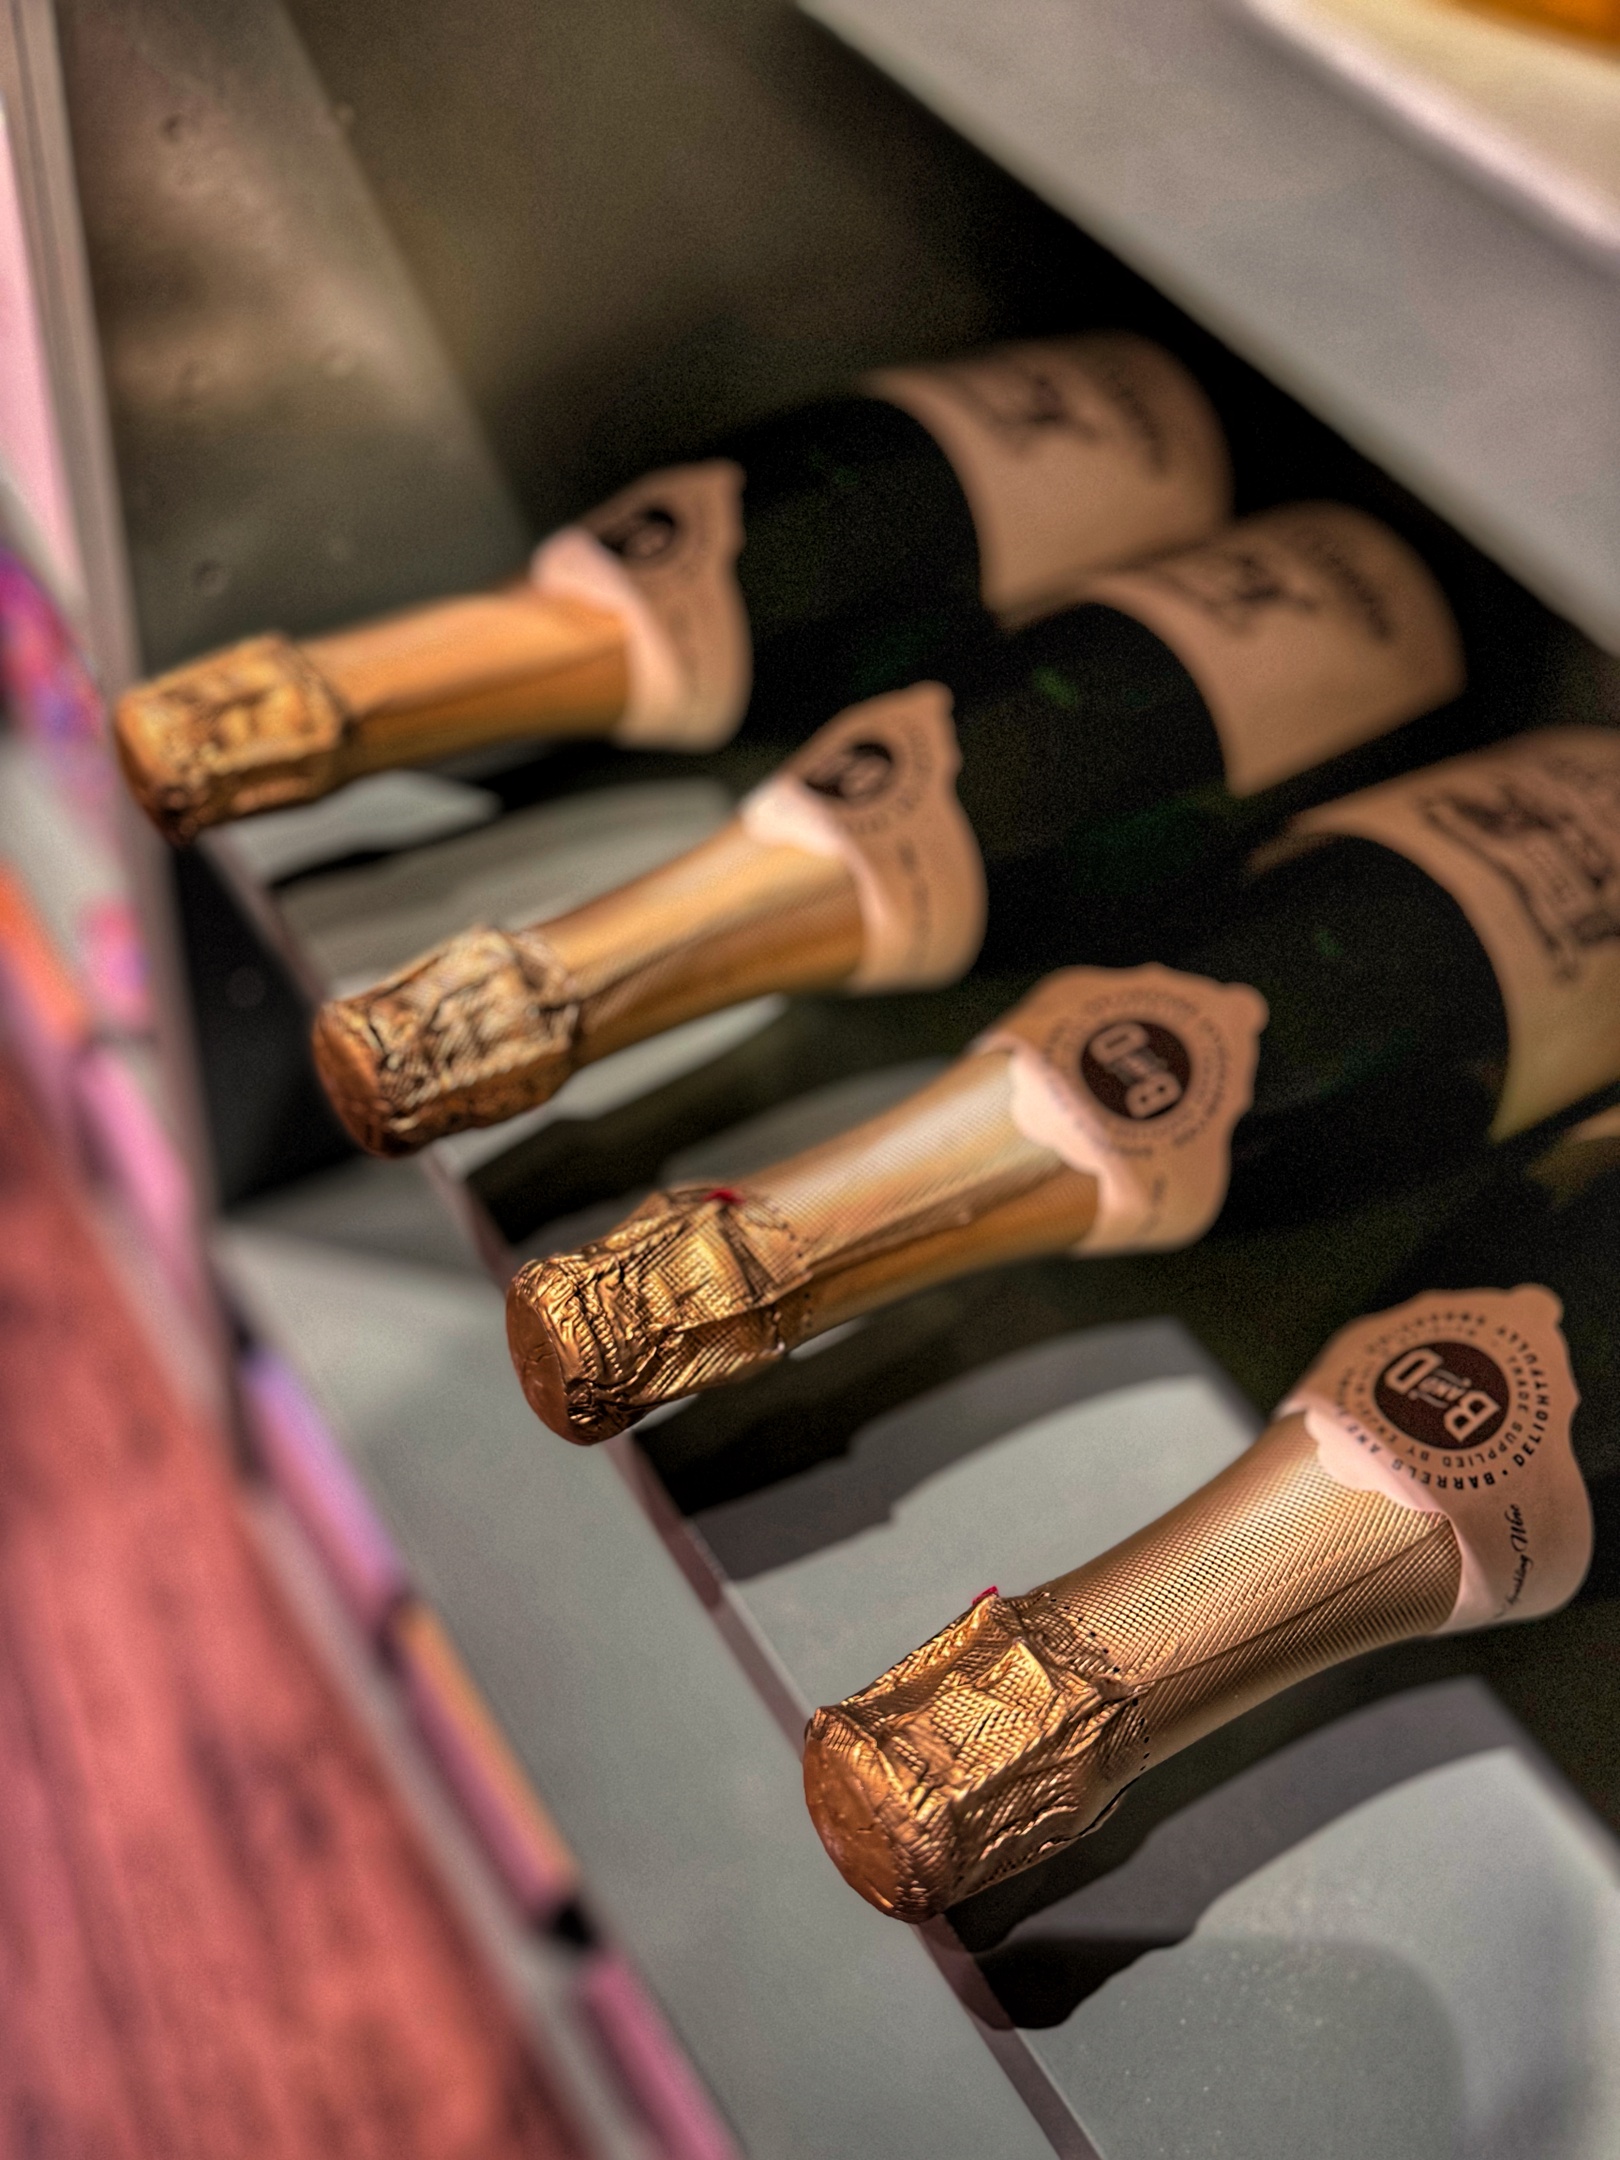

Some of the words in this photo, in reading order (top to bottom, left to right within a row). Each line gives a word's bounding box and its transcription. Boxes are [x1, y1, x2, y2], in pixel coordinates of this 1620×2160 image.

[1384, 1347, 1444, 1395] D
[1442, 1389, 1502, 1444] B
[1405, 1446, 1430, 1462] BY
[1441, 1421, 1524, 1469] SUPPLIED
[1391, 1458, 1496, 1491] BARRELS
